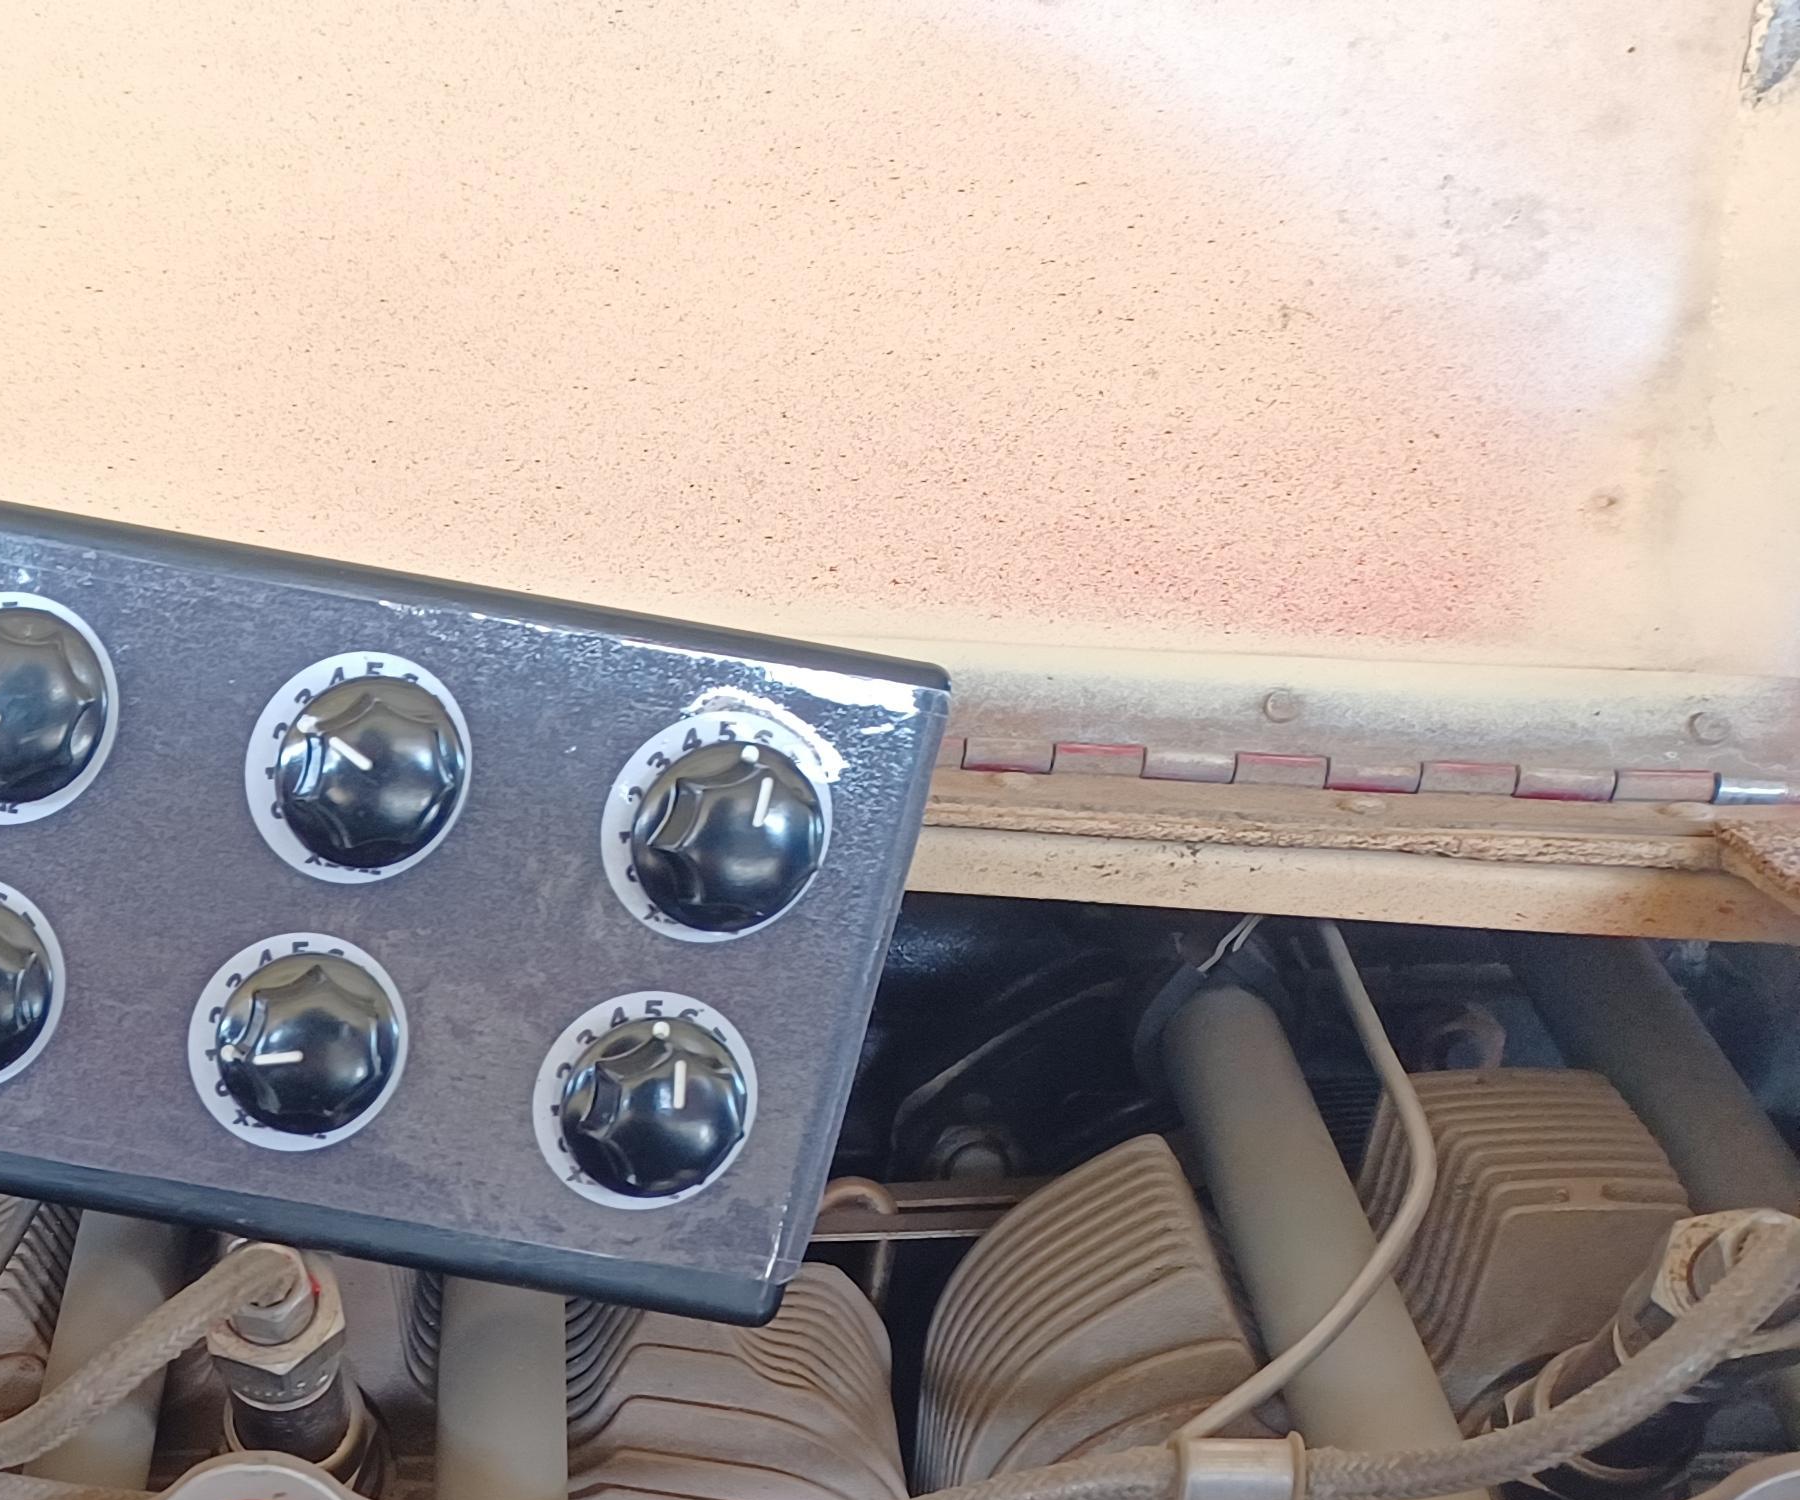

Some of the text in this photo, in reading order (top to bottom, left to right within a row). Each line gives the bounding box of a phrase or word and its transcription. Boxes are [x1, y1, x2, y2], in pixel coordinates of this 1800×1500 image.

[647, 751, 671, 774] 3
[682, 727, 702, 751] 4
[718, 721, 738, 742] 5
[610, 1006, 629, 1028] 4
[644, 1000, 664, 1018] 5
